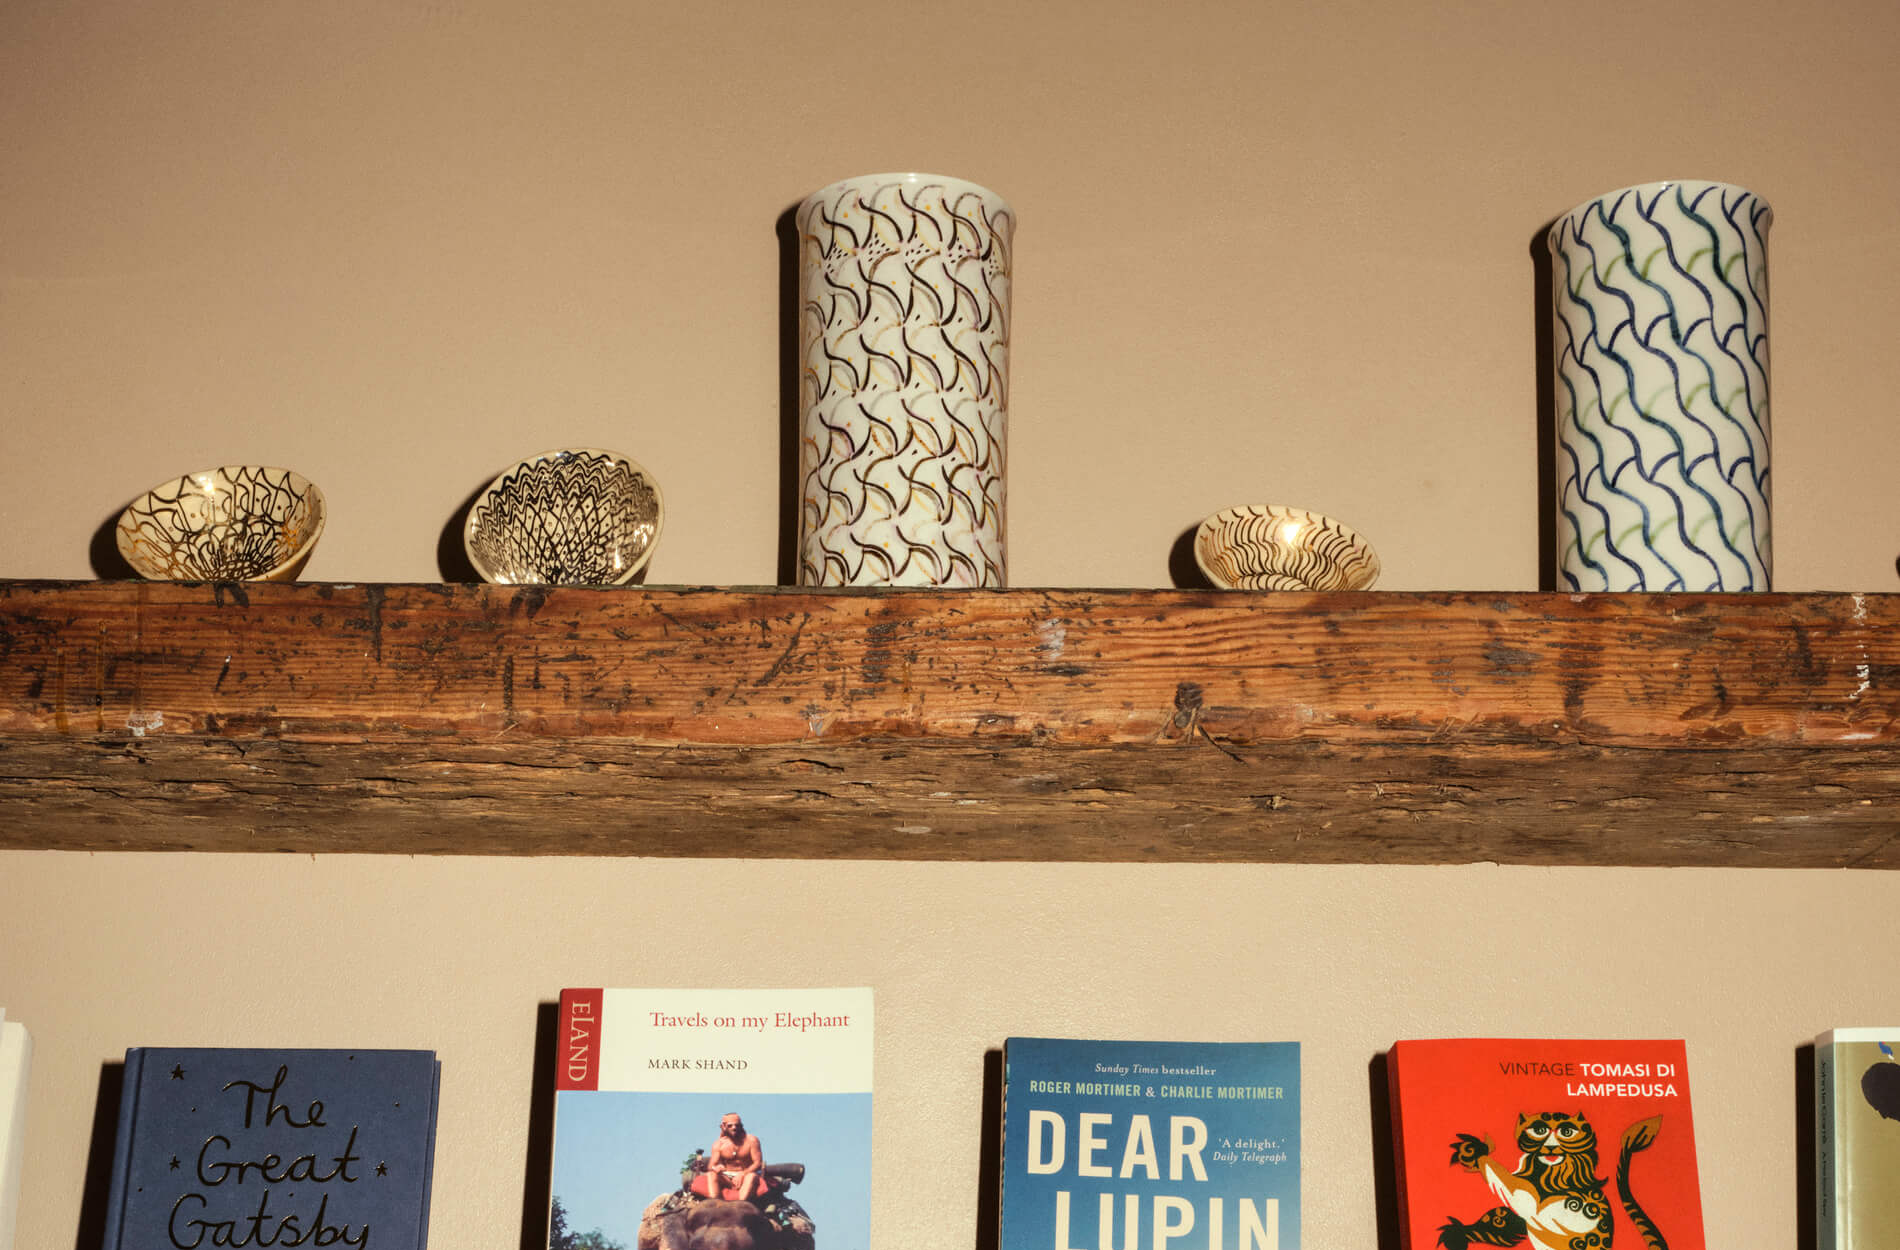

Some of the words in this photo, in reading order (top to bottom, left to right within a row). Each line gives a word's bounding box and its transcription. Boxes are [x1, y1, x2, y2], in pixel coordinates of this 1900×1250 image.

[649, 1012, 708, 1028] Travels
[714, 1016, 735, 1028] on
[742, 1016, 768, 1032] my
[775, 1012, 850, 1032] Elephant
[568, 1001, 594, 1082] ELAND
[648, 1059, 691, 1070] MARK
[695, 1059, 748, 1071] SHAND
[1095, 1063, 1129, 1077] Sunday
[1132, 1063, 1159, 1075] Times
[1161, 1064, 1216, 1077] bestseller
[1500, 1062, 1575, 1077] VINTAGE
[1580, 1063, 1650, 1077] TOMASI
[1657, 1063, 1675, 1077] DI
[222, 1064, 327, 1128] The
[1029, 1080, 1071, 1095] ROGER
[1076, 1082, 1141, 1097] MORTIMER
[1145, 1086, 1155, 1097] &
[1161, 1085, 1213, 1099] CHARLIE
[1218, 1086, 1283, 1100] MORTIMER
[1566, 1083, 1677, 1097] LAMPEDUSA
[197, 1126, 359, 1186] Great
[1027, 1110, 1209, 1182] DEAR
[1213, 1151, 1239, 1164] Daily
[1241, 1151, 1287, 1165] Telegraph
